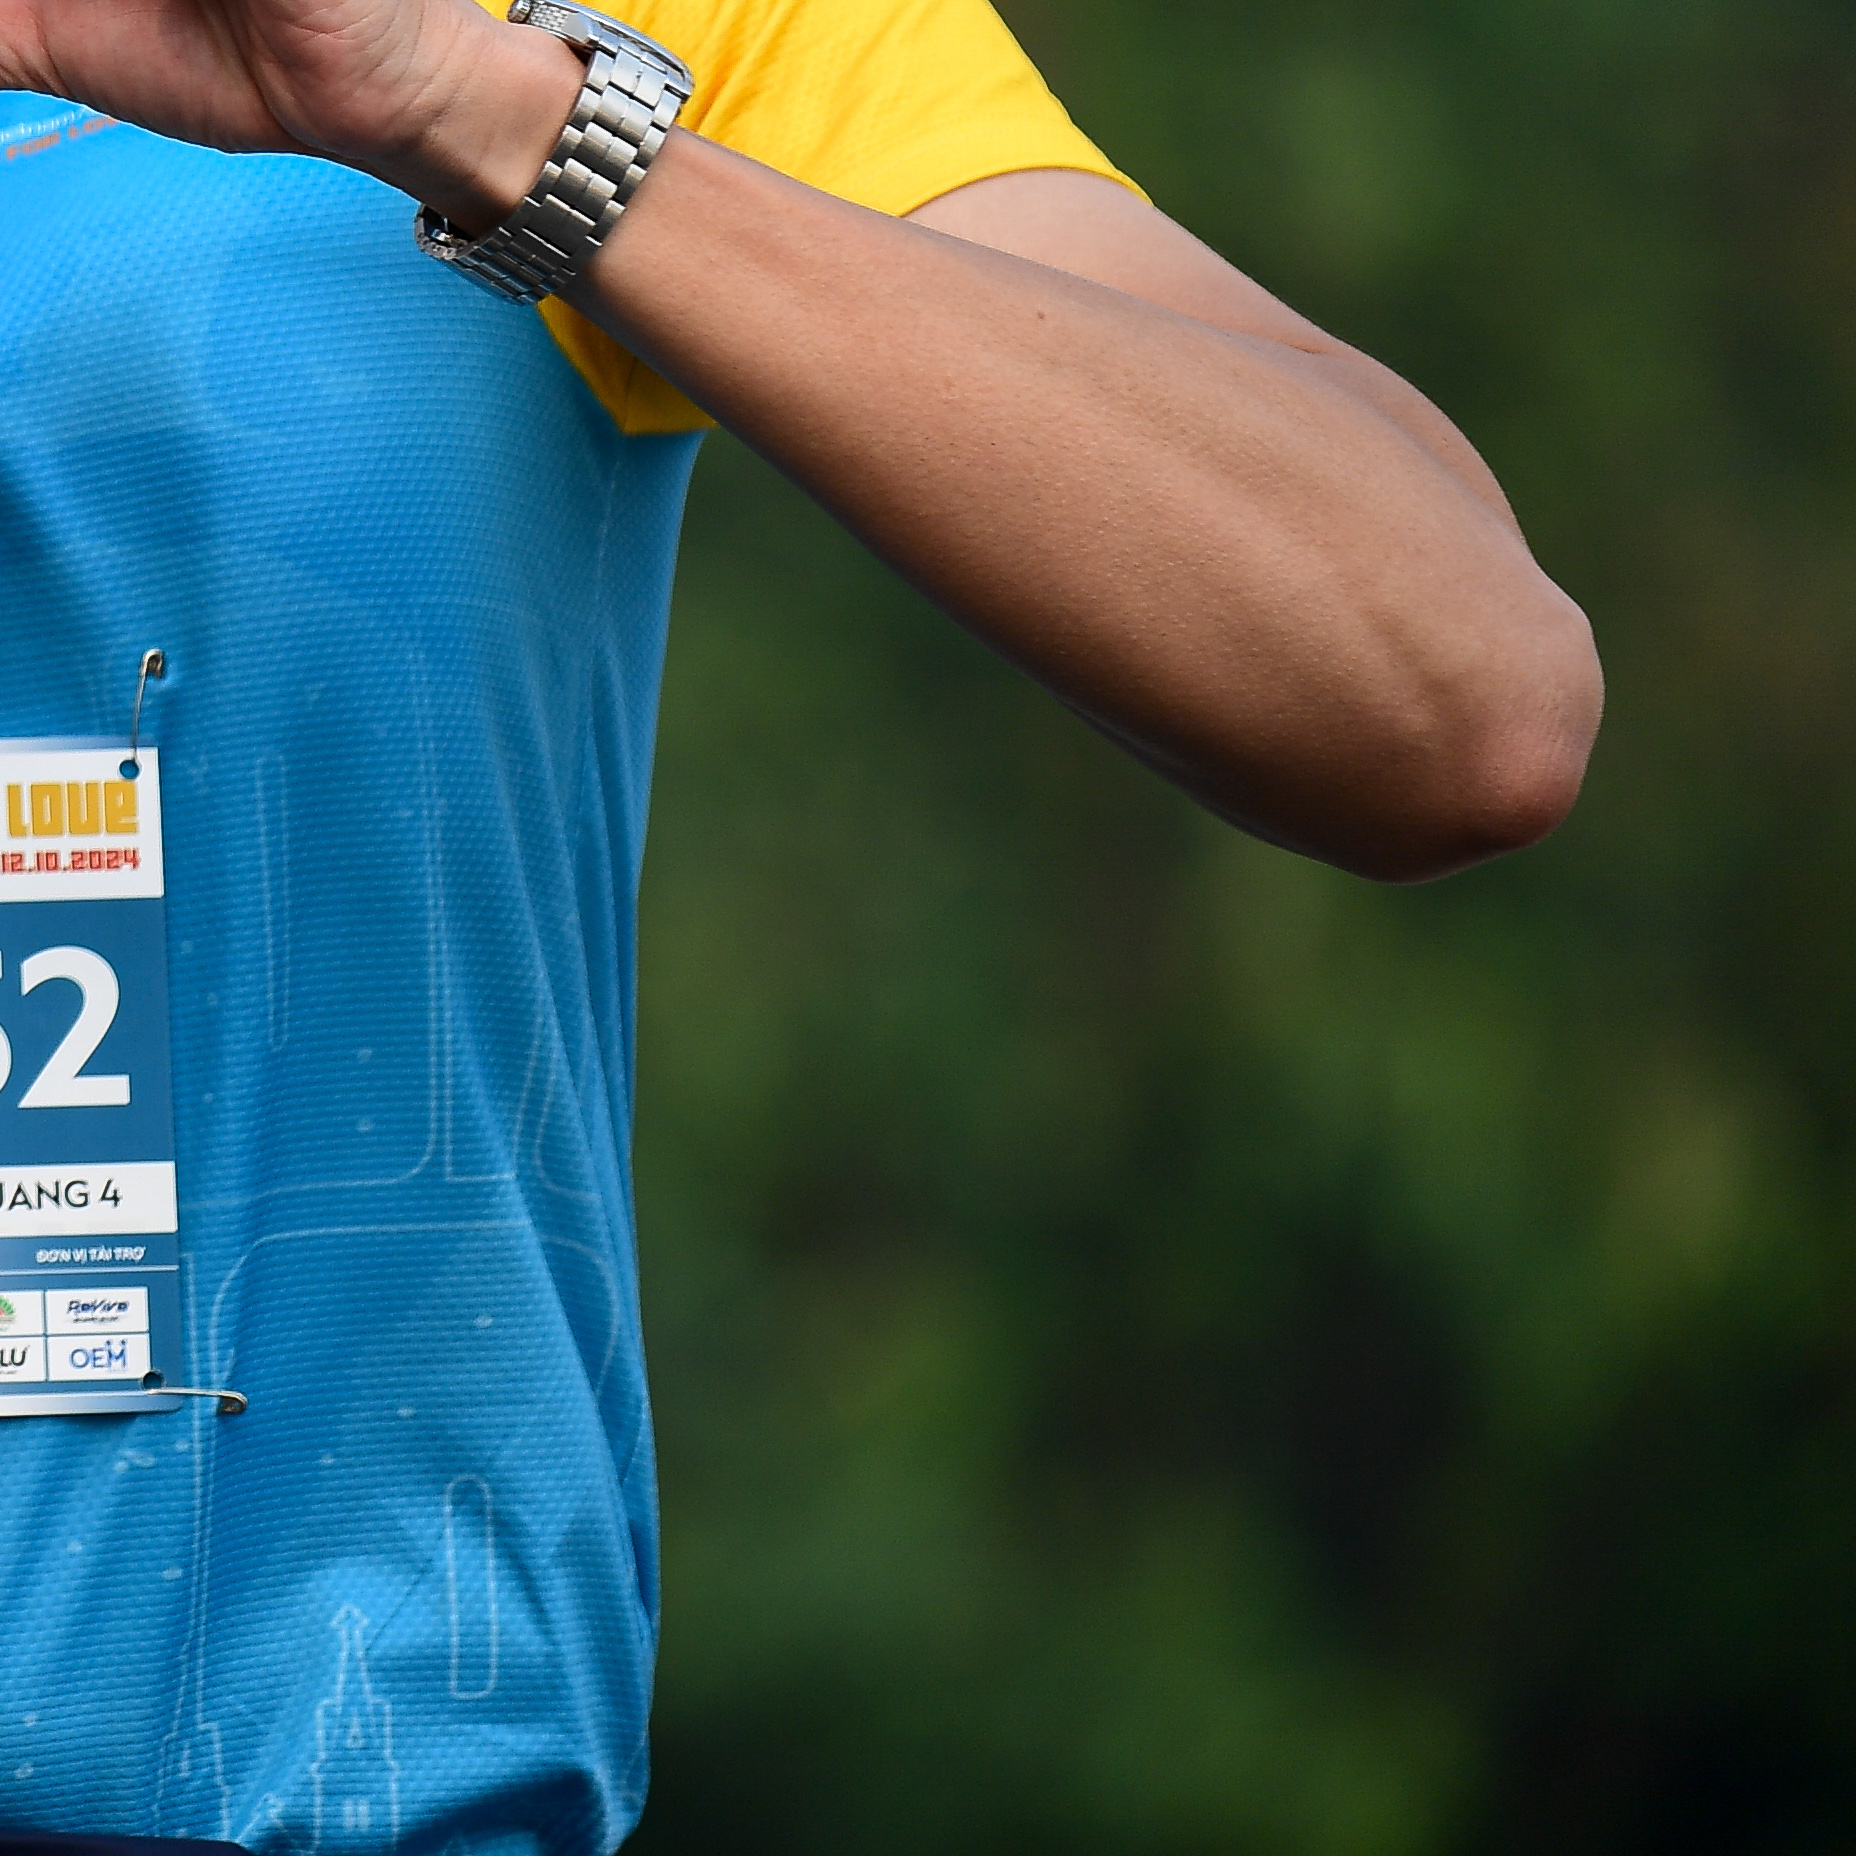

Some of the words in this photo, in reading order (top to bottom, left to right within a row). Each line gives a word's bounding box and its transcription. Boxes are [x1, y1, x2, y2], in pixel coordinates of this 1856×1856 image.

[0, 847, 140, 875] 12.10.2024
[100, 1178, 122, 1208] 4
[70, 1340, 127, 1370] OEM
